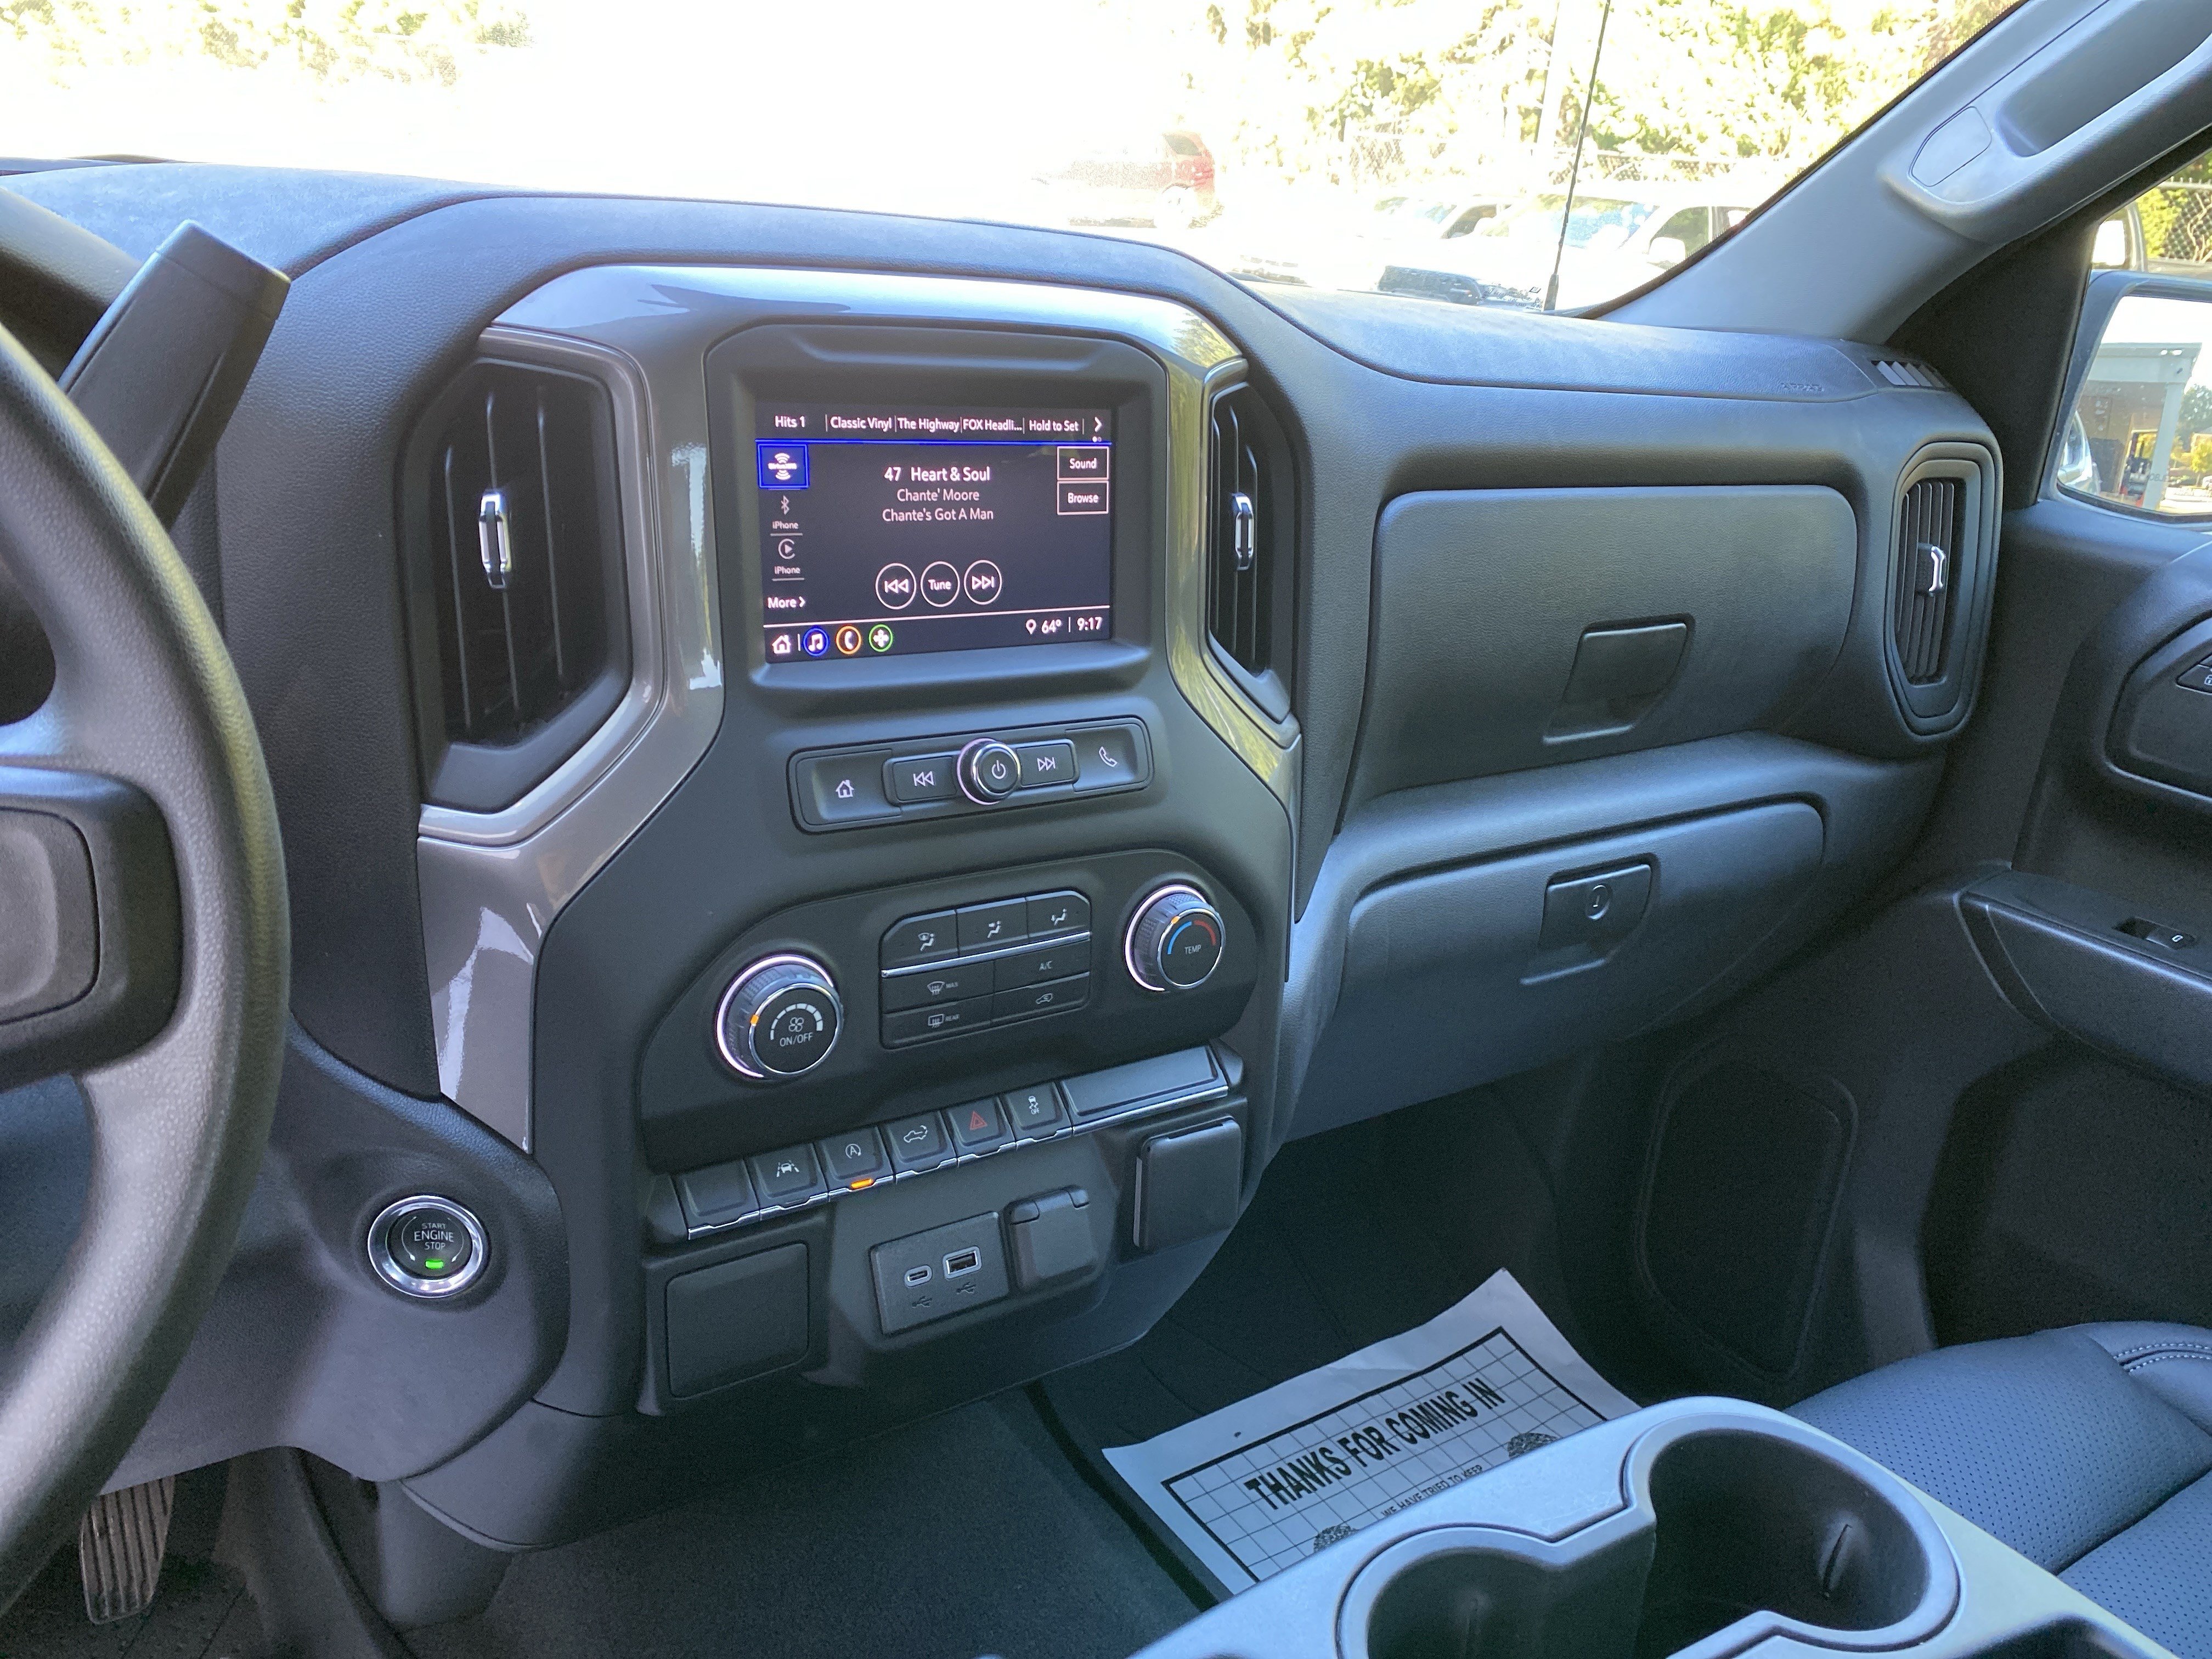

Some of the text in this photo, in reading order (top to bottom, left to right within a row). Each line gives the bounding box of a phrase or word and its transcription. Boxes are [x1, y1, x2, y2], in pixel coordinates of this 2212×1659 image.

[775, 415, 805, 427] Hits 1
[830, 416, 891, 432] Classic Vinyl
[898, 417, 959, 432] The Highway
[963, 419, 1022, 431] FOX Headli...
[1029, 420, 1079, 431] Hold to Set
[1069, 458, 1097, 470] Sound
[884, 466, 991, 481] 47 Heart & Soul
[897, 488, 980, 501] Chante' Moore
[1068, 493, 1099, 504] Browse
[882, 507, 994, 522] Chante's Got A Man
[772, 521, 799, 529] iPhone
[774, 566, 800, 574] iPhone
[928, 579, 951, 590] Tune
[768, 596, 797, 608] More
[1077, 617, 1103, 631] 9:17
[1184, 944, 1201, 955] TEMP
[1039, 961, 1053, 971] A/C
[780, 1032, 814, 1047] ON/OFF
[414, 1230, 455, 1243] ENGINE
[425, 1242, 445, 1250] STOP
[1244, 1378, 1506, 1510] THANKS FOR COMING IN
[1381, 1505, 1397, 1517] WE
[1397, 1492, 1422, 1509] HAVE
[1420, 1480, 1451, 1497] TRIED
[1447, 1475, 1463, 1485] TO
